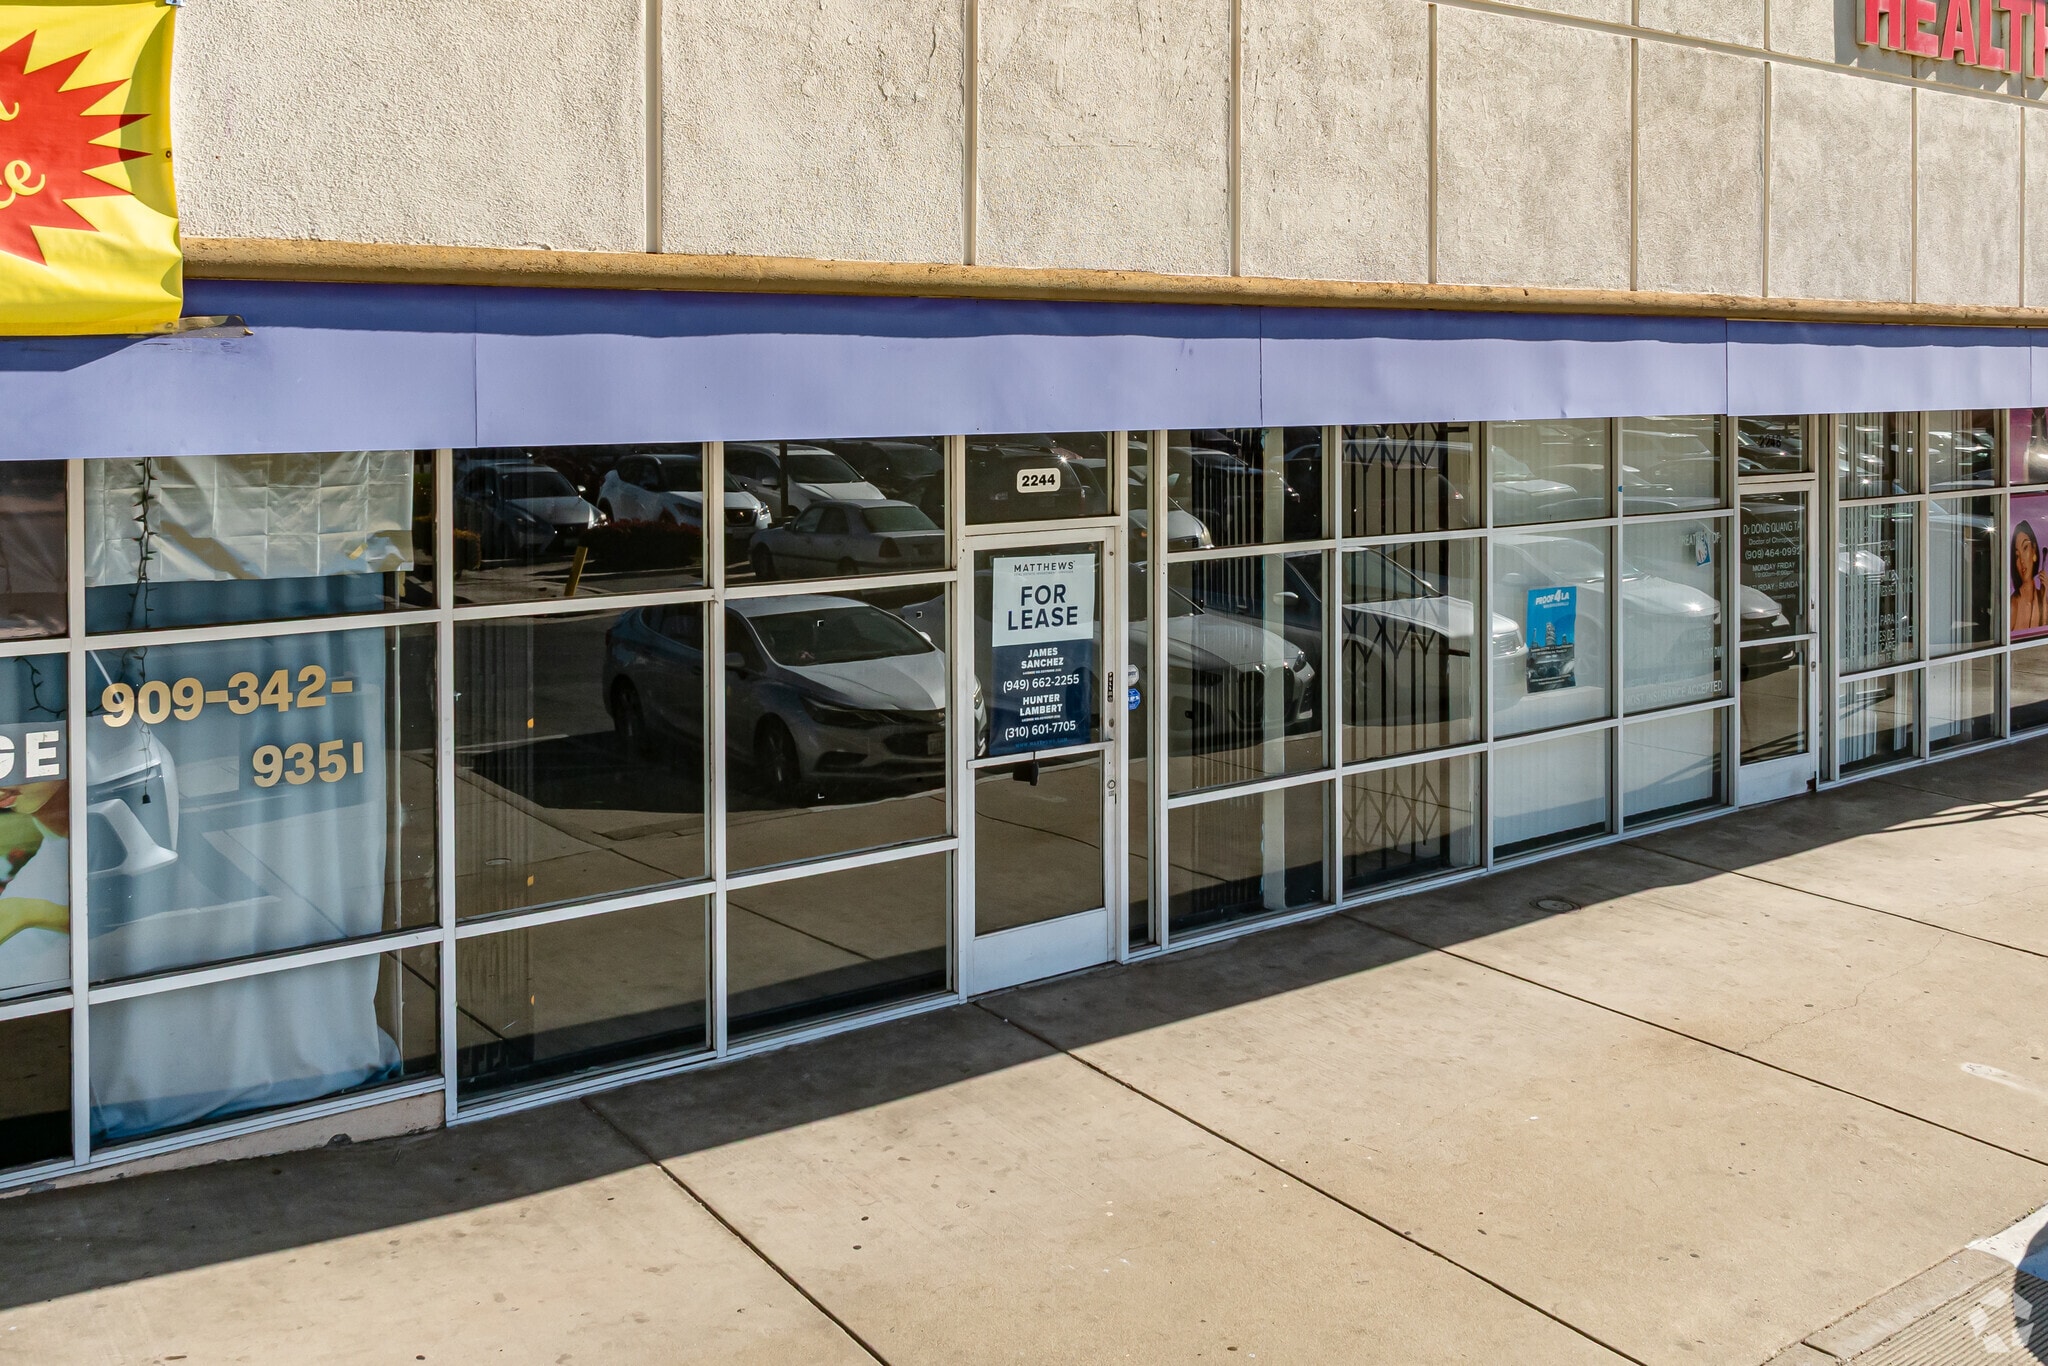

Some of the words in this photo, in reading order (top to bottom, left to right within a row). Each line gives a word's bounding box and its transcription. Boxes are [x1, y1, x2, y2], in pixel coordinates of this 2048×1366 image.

[1021, 472, 1056, 487] 2244
[1745, 549, 1764, 560] (909)
[1014, 560, 1074, 573] MATTHEWS
[1752, 563, 1776, 572] MONDAY
[1777, 561, 1796, 570] FRIDAY
[1021, 584, 1066, 606] FOR
[1008, 606, 1078, 631] LEASE
[1027, 647, 1058, 658] JAMES
[1021, 657, 1064, 669] SANCHEZ
[1003, 679, 1029, 693] (949)
[1032, 674, 1079, 689] 662-2255
[1688, 680, 1722, 696] ACCEPTED
[102, 665, 353, 727] 909-342-
[1022, 693, 1060, 705] HUNTER
[1019, 704, 1063, 717] LAMBERT
[1005, 726, 1029, 740] (310)
[1032, 720, 1076, 735] 601-7705
[252, 740, 364, 788] 9351
